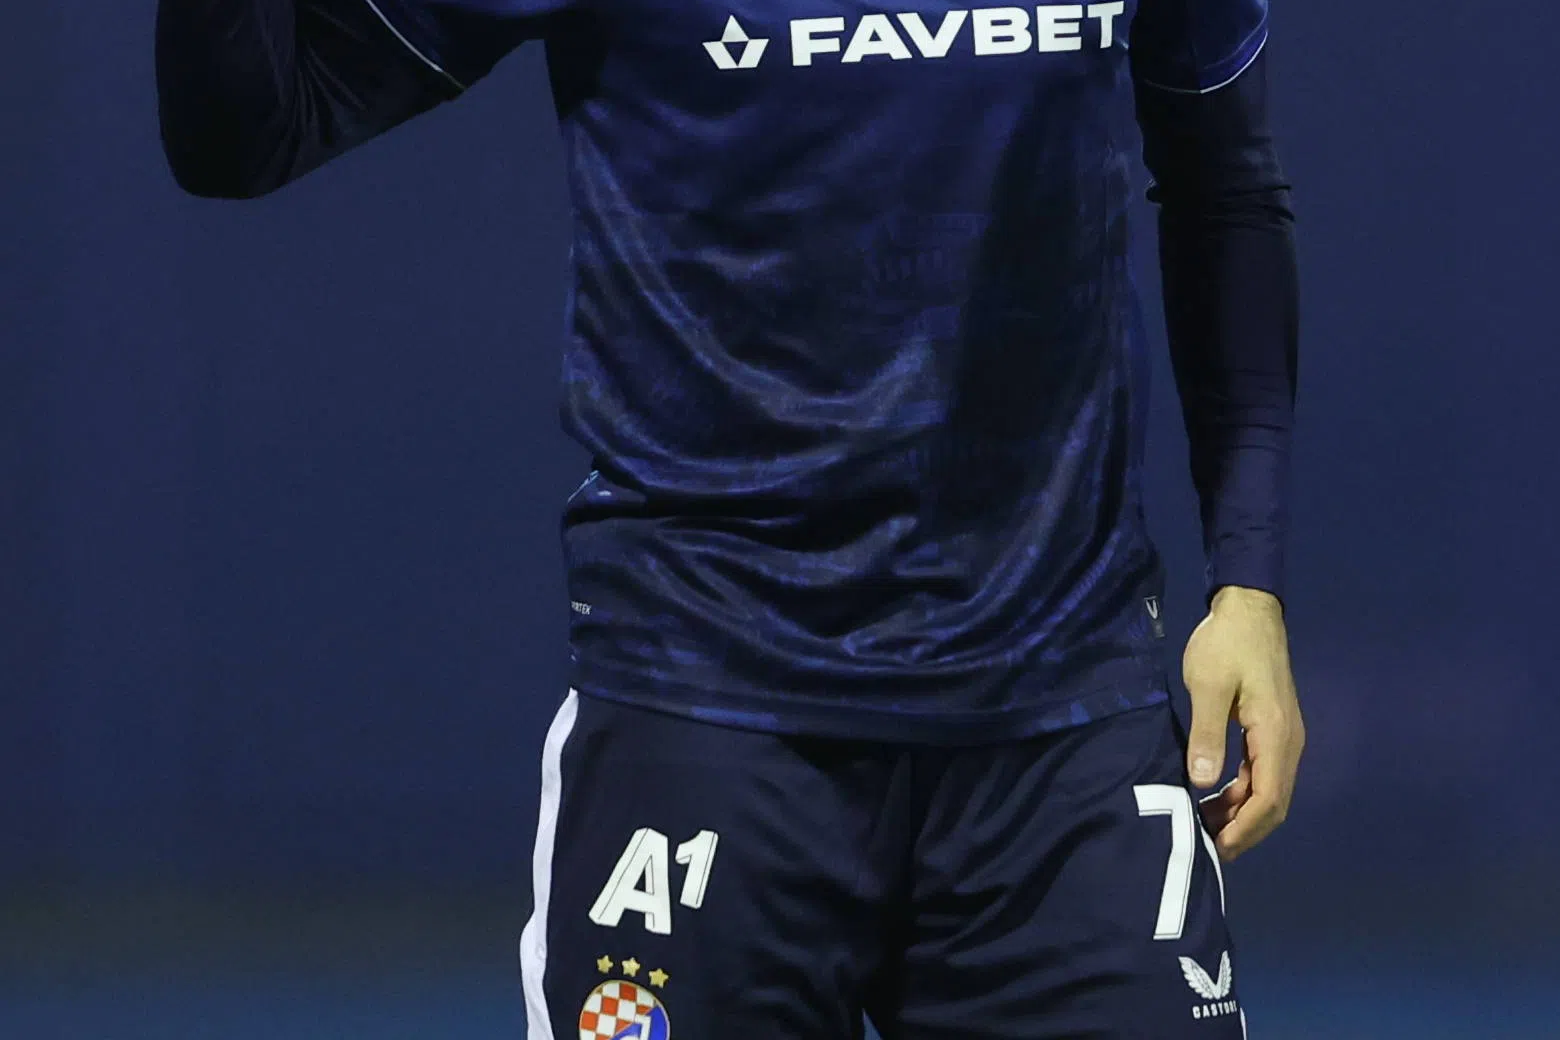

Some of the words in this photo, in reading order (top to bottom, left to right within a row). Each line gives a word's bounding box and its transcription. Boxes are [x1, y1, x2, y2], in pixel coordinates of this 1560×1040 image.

[789, 0, 1129, 67] FAVBET
[588, 827, 719, 935] A1
[1133, 783, 1197, 940] 7
